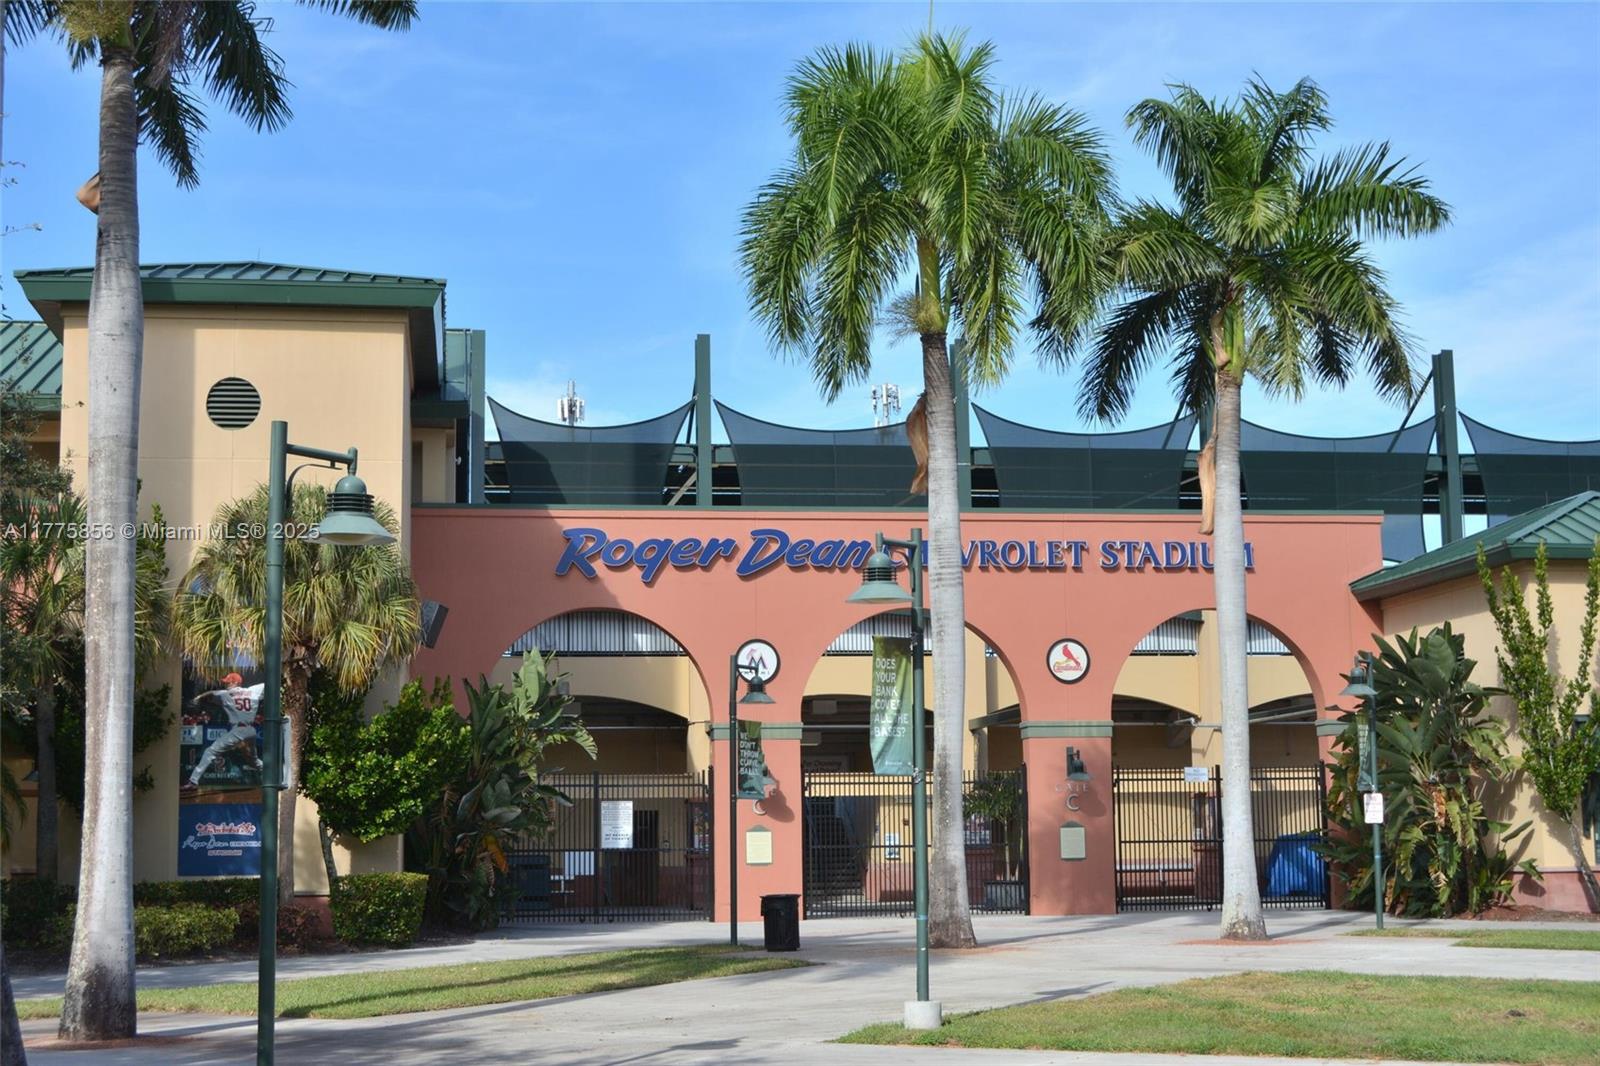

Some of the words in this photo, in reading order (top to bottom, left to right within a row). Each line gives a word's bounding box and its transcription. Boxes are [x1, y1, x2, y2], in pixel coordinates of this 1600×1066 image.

[555, 527, 736, 583] Roger
[736, 528, 873, 576] Dean
[1100, 540, 1254, 568] STADIU
[875, 658, 896, 670] DOES
[875, 671, 897, 683] YOUR
[875, 686, 898, 697] BANK
[234, 697, 252, 712] 50
[1066, 793, 1081, 811] C
